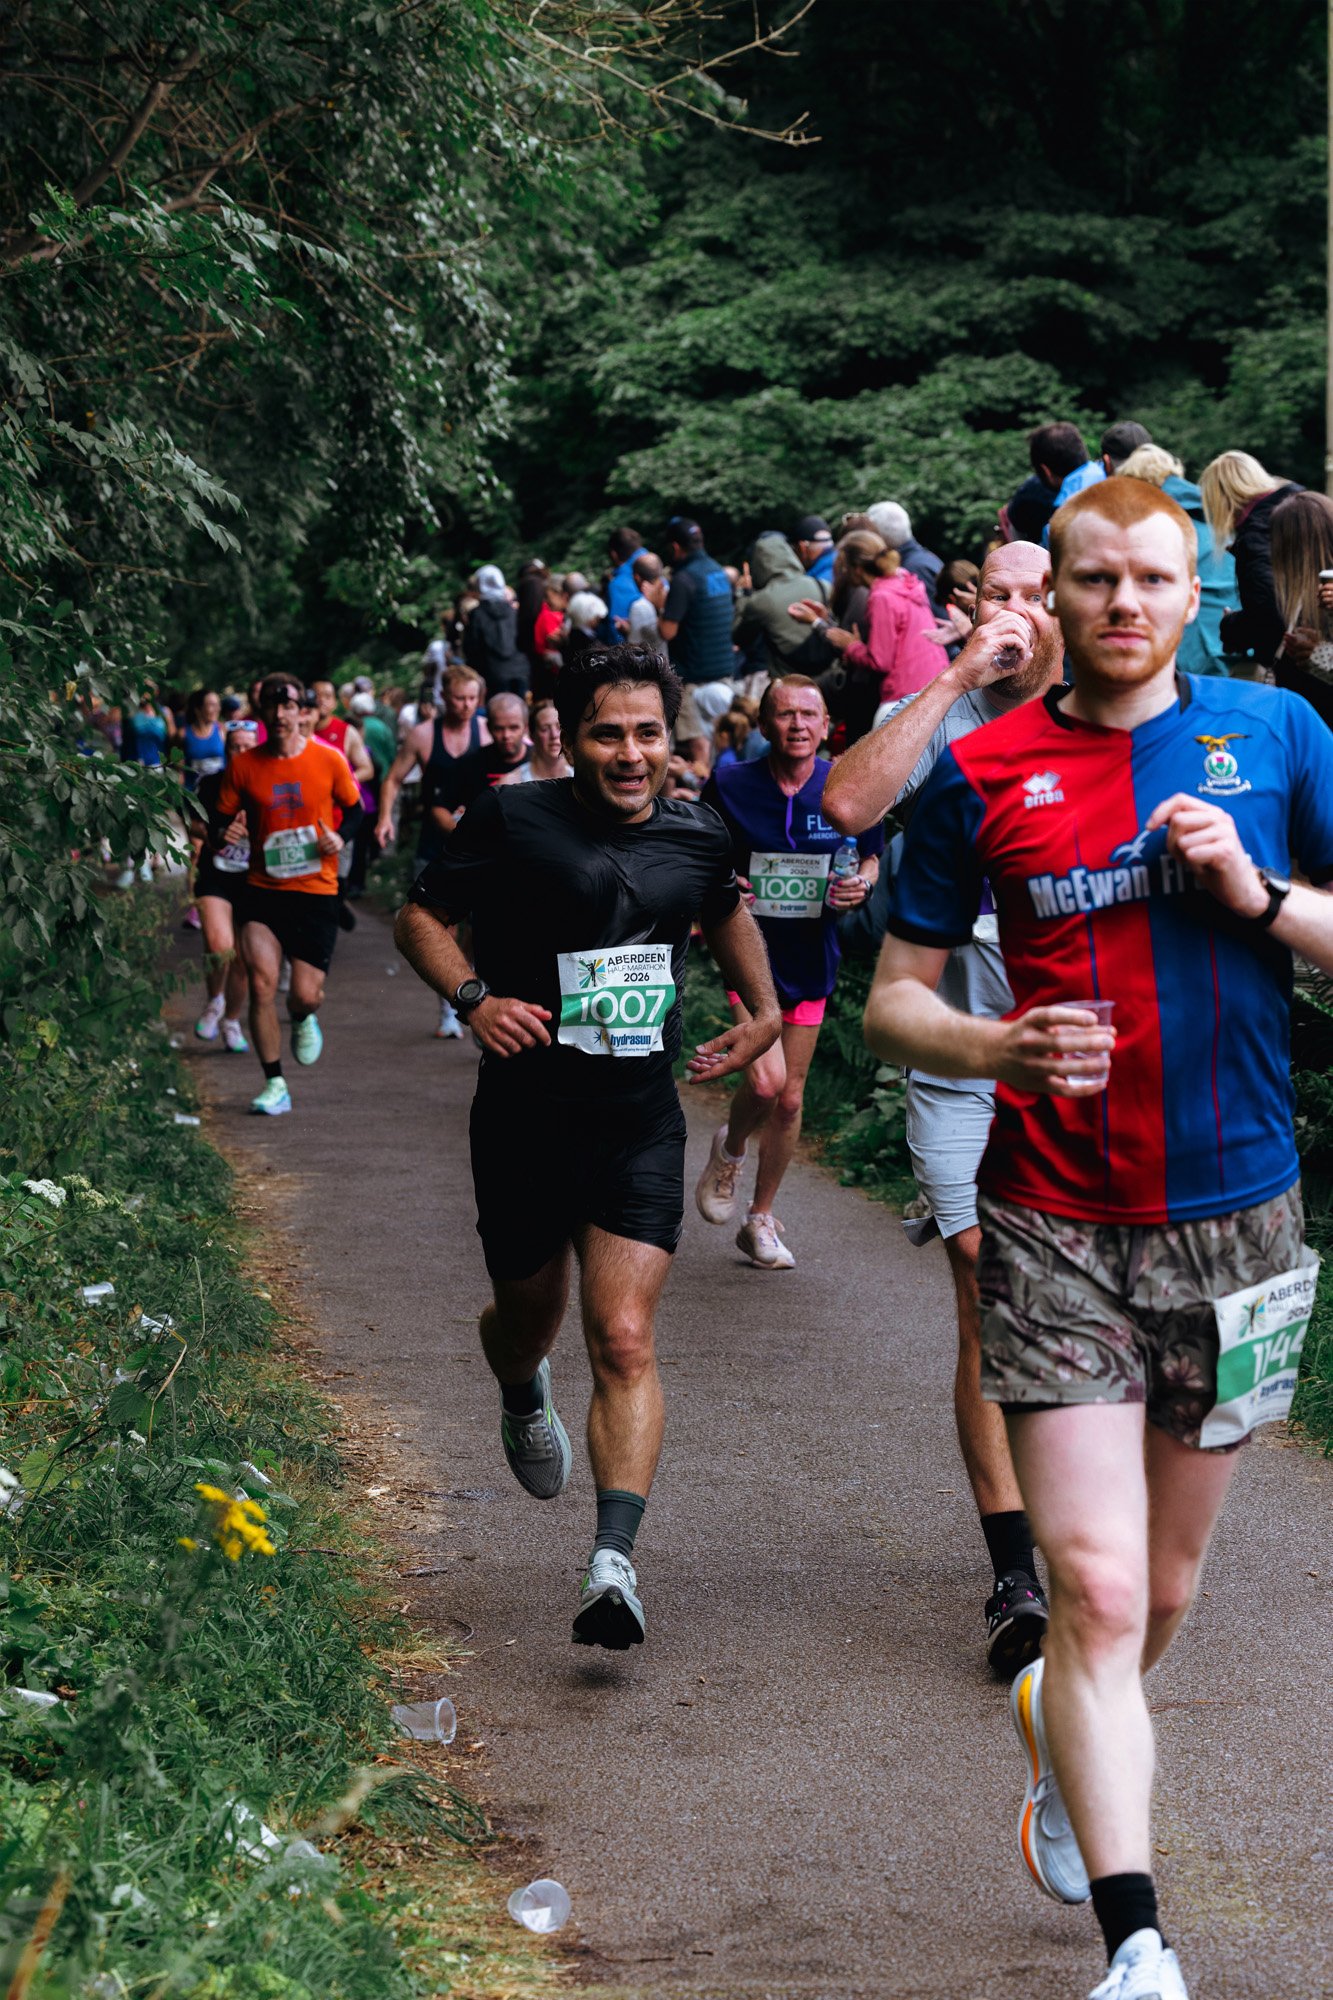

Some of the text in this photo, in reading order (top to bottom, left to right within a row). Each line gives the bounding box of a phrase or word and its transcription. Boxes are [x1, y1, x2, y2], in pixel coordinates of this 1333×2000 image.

[806, 814, 833, 831] FL
[760, 878, 818, 899] 1008
[1027, 865, 1151, 919] McEwan
[607, 953, 666, 967] ABERDEEN
[607, 963, 666, 975] HALF MARATHON
[623, 972, 650, 983] 2026
[580, 989, 666, 1025] 1007
[610, 1033, 651, 1047] hydrasun
